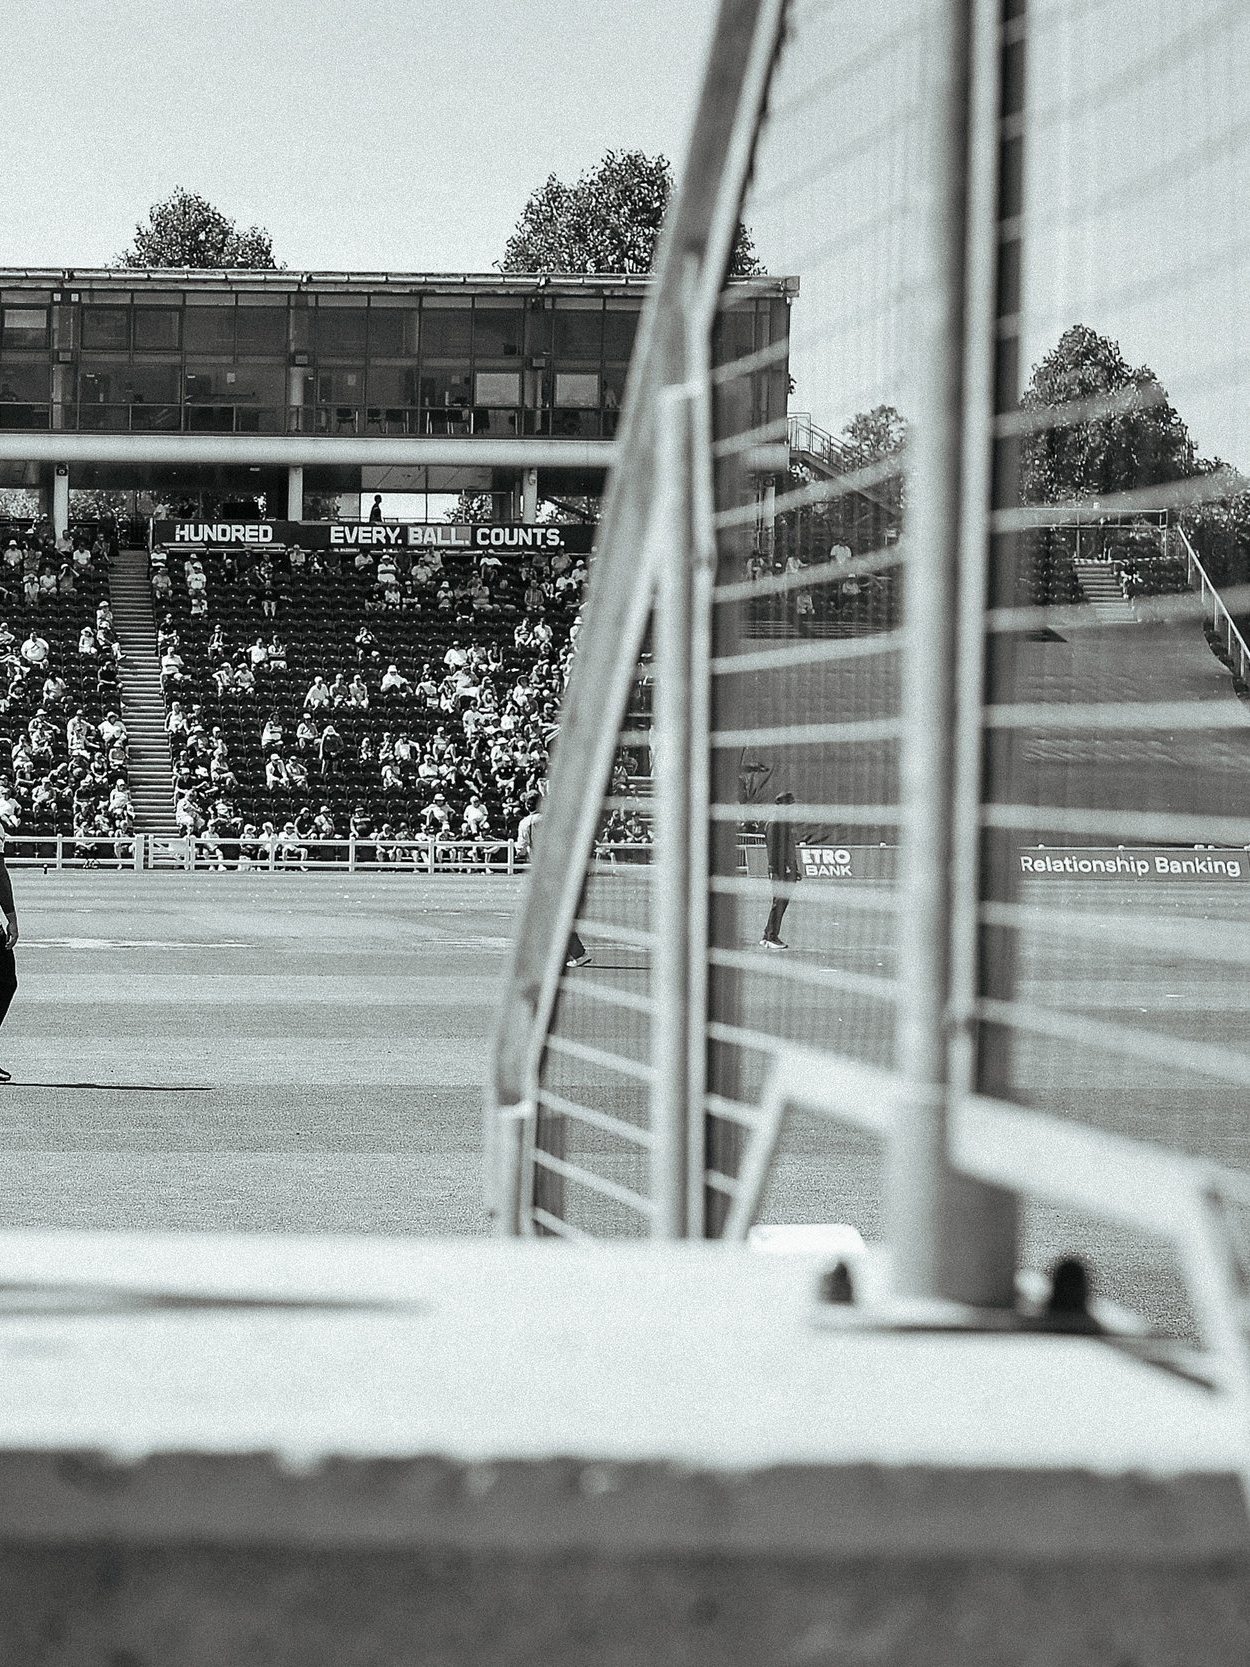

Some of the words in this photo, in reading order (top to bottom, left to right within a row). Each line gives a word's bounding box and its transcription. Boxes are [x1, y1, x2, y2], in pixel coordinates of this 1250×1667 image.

[175, 524, 273, 542] HUNDRED
[330, 526, 402, 544] EVERY.
[409, 527, 470, 546] BALL.
[476, 528, 565, 546] COUNTS.
[801, 849, 851, 864] ETRO
[806, 865, 852, 876] BANK
[1020, 856, 1150, 876] Relationship
[1154, 856, 1241, 877] Banking
